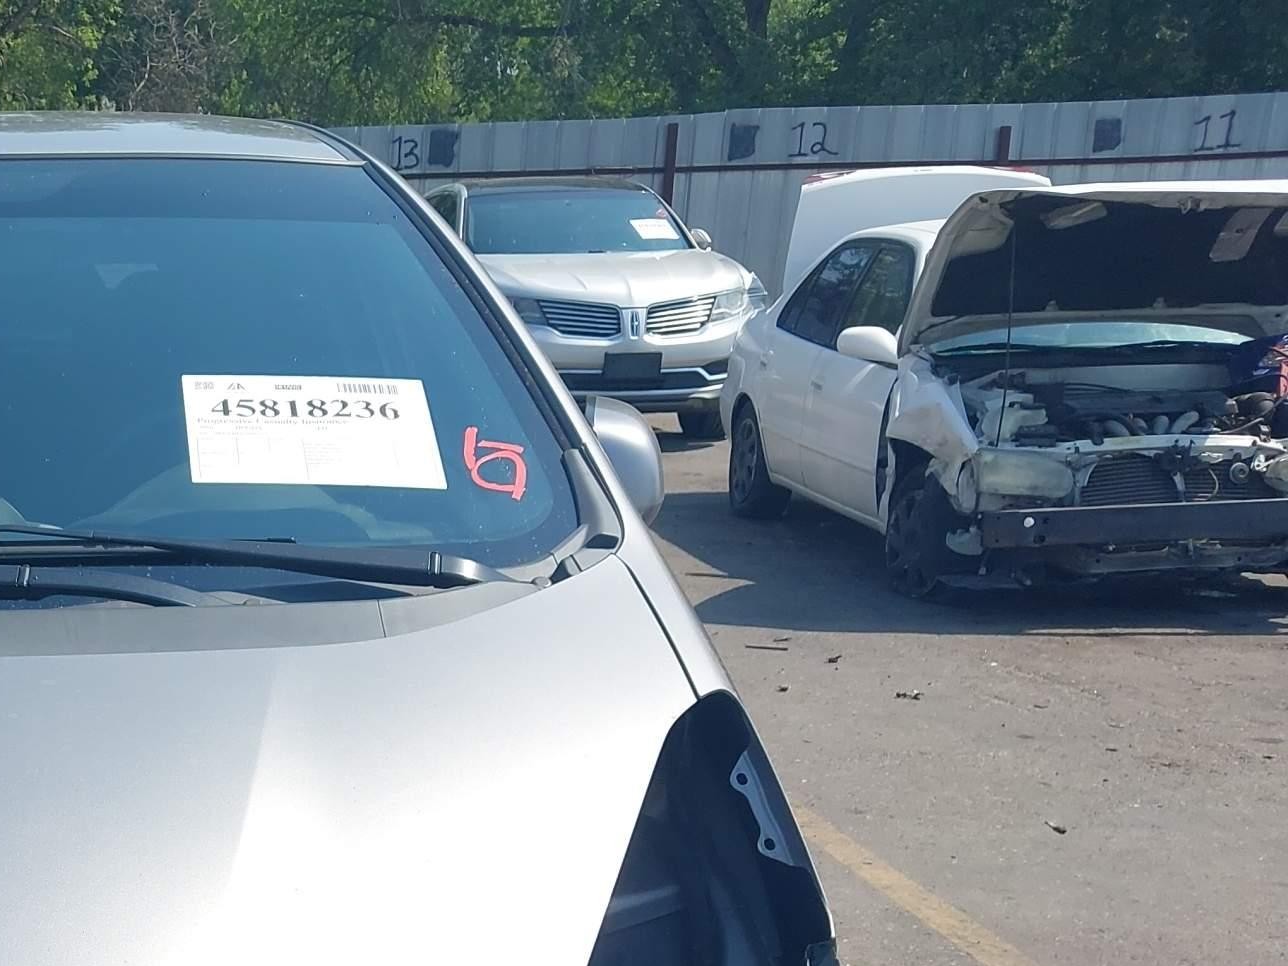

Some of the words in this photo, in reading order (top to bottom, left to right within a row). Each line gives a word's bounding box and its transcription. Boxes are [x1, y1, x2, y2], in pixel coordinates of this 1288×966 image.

[788, 121, 839, 157] 12
[1194, 109, 1242, 152] 11
[391, 136, 420, 171] 13
[210, 398, 401, 420] 45818236
